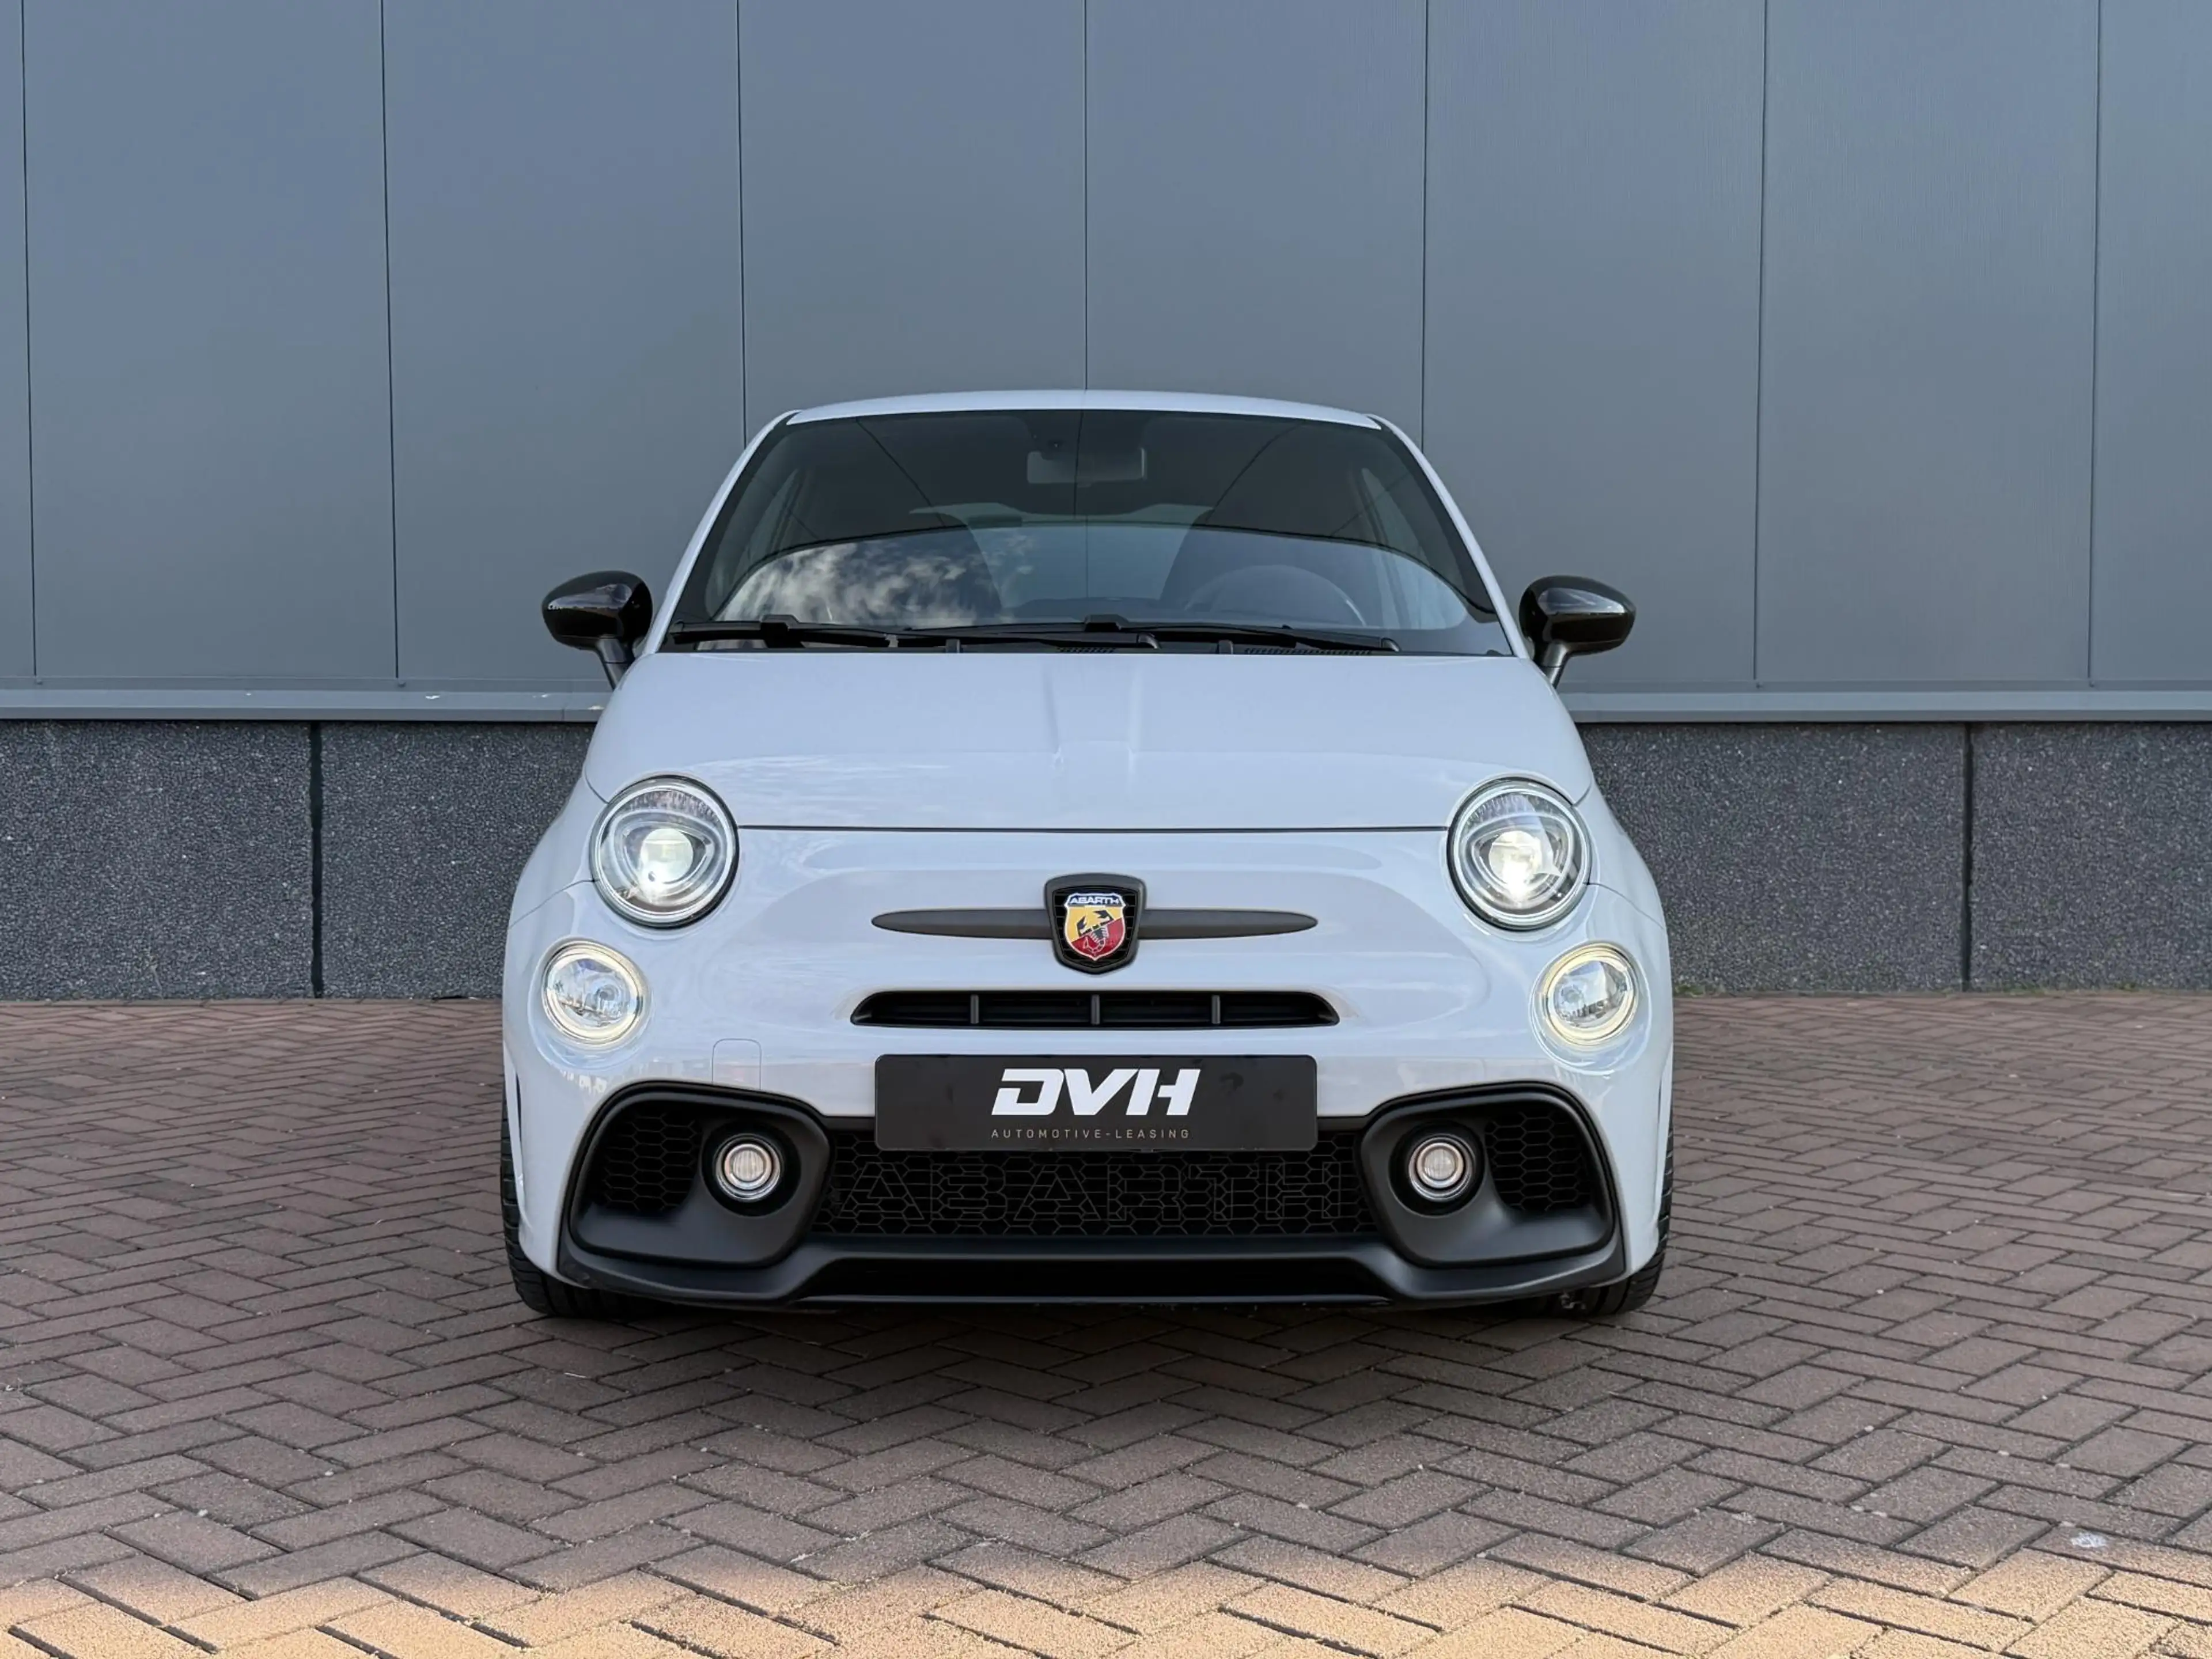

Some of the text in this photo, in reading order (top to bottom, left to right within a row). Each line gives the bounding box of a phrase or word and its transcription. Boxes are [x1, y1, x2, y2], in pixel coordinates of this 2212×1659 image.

[991, 1068, 1200, 1116] DVH
[991, 1129, 1190, 1139] AUTOMOTIVE-LEASING
[840, 1161, 1341, 1221] ABARTH
